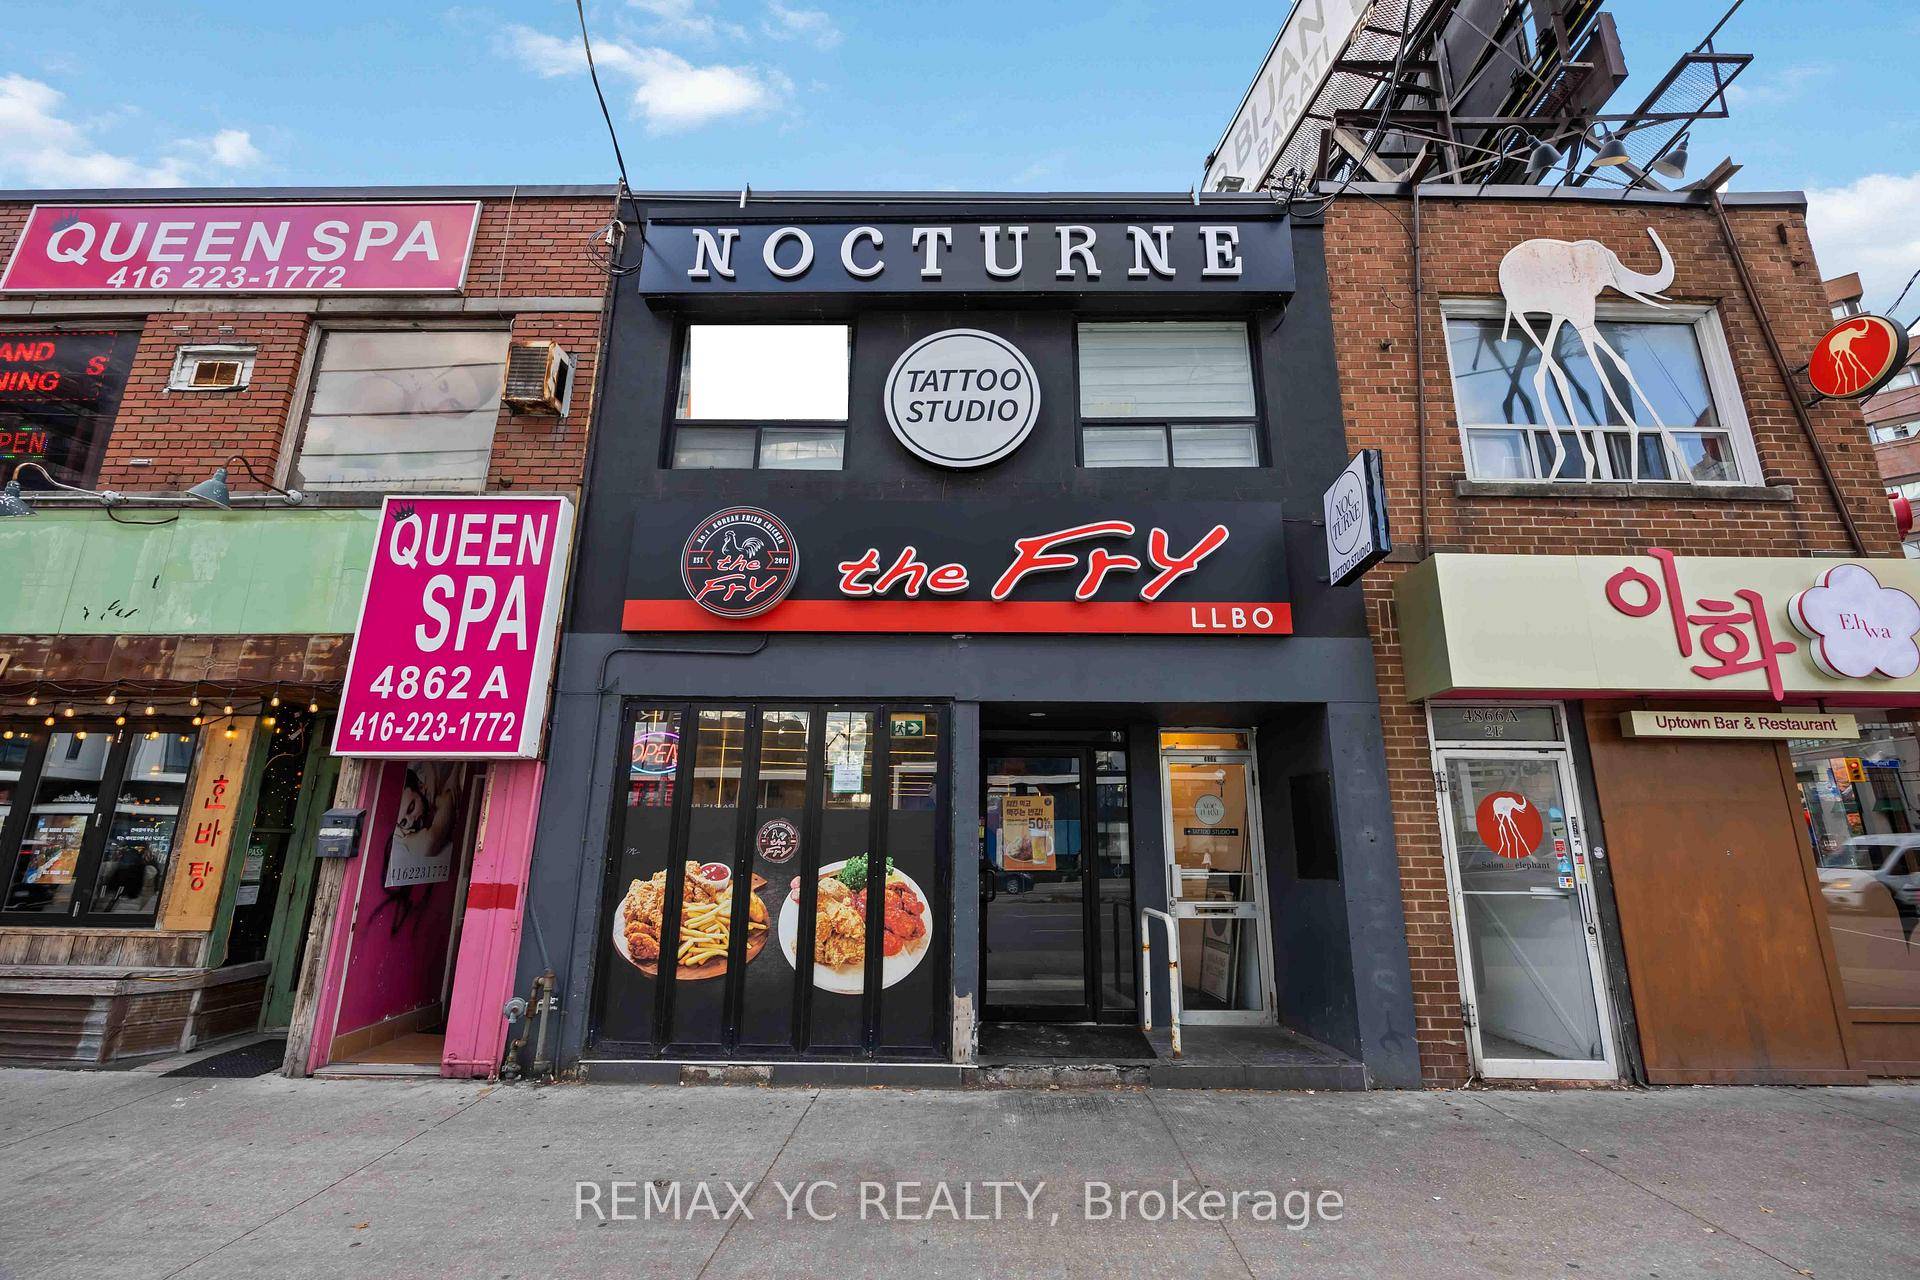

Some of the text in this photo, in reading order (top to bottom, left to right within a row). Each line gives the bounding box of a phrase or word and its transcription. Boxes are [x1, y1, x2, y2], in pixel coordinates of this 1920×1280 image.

[45, 220, 441, 264] QUEEN SPA
[687, 224, 1244, 279] NOCTURNE
[107, 265, 347, 289] 416 223-1772
[906, 366, 1022, 394] TATTOO
[905, 398, 1019, 424] STUDIO
[1335, 488, 1354, 517] NOC
[711, 515, 740, 530] KOREAN
[741, 514, 763, 524] FRIED
[763, 521, 786, 544] CHICKEN
[1331, 500, 1361, 541] TURNE
[388, 512, 550, 568] QUEEN
[716, 554, 762, 572] the
[838, 518, 1231, 603] the Fry
[1331, 541, 1371, 582] TATTOO STUDIO
[695, 573, 778, 602] Fry
[414, 574, 529, 654] SPA
[1190, 606, 1275, 630] LLBO
[1605, 547, 1798, 701] 이화
[369, 665, 510, 700] 4862 A
[349, 711, 516, 743] 416-223-1772
[1462, 708, 1521, 723] 4866A
[1655, 715, 1839, 732] Uptown Bar & Restaurant
[247, 847, 264, 857] PASS
[1481, 861, 1504, 869] Salon
[1514, 861, 1551, 872] elephant
